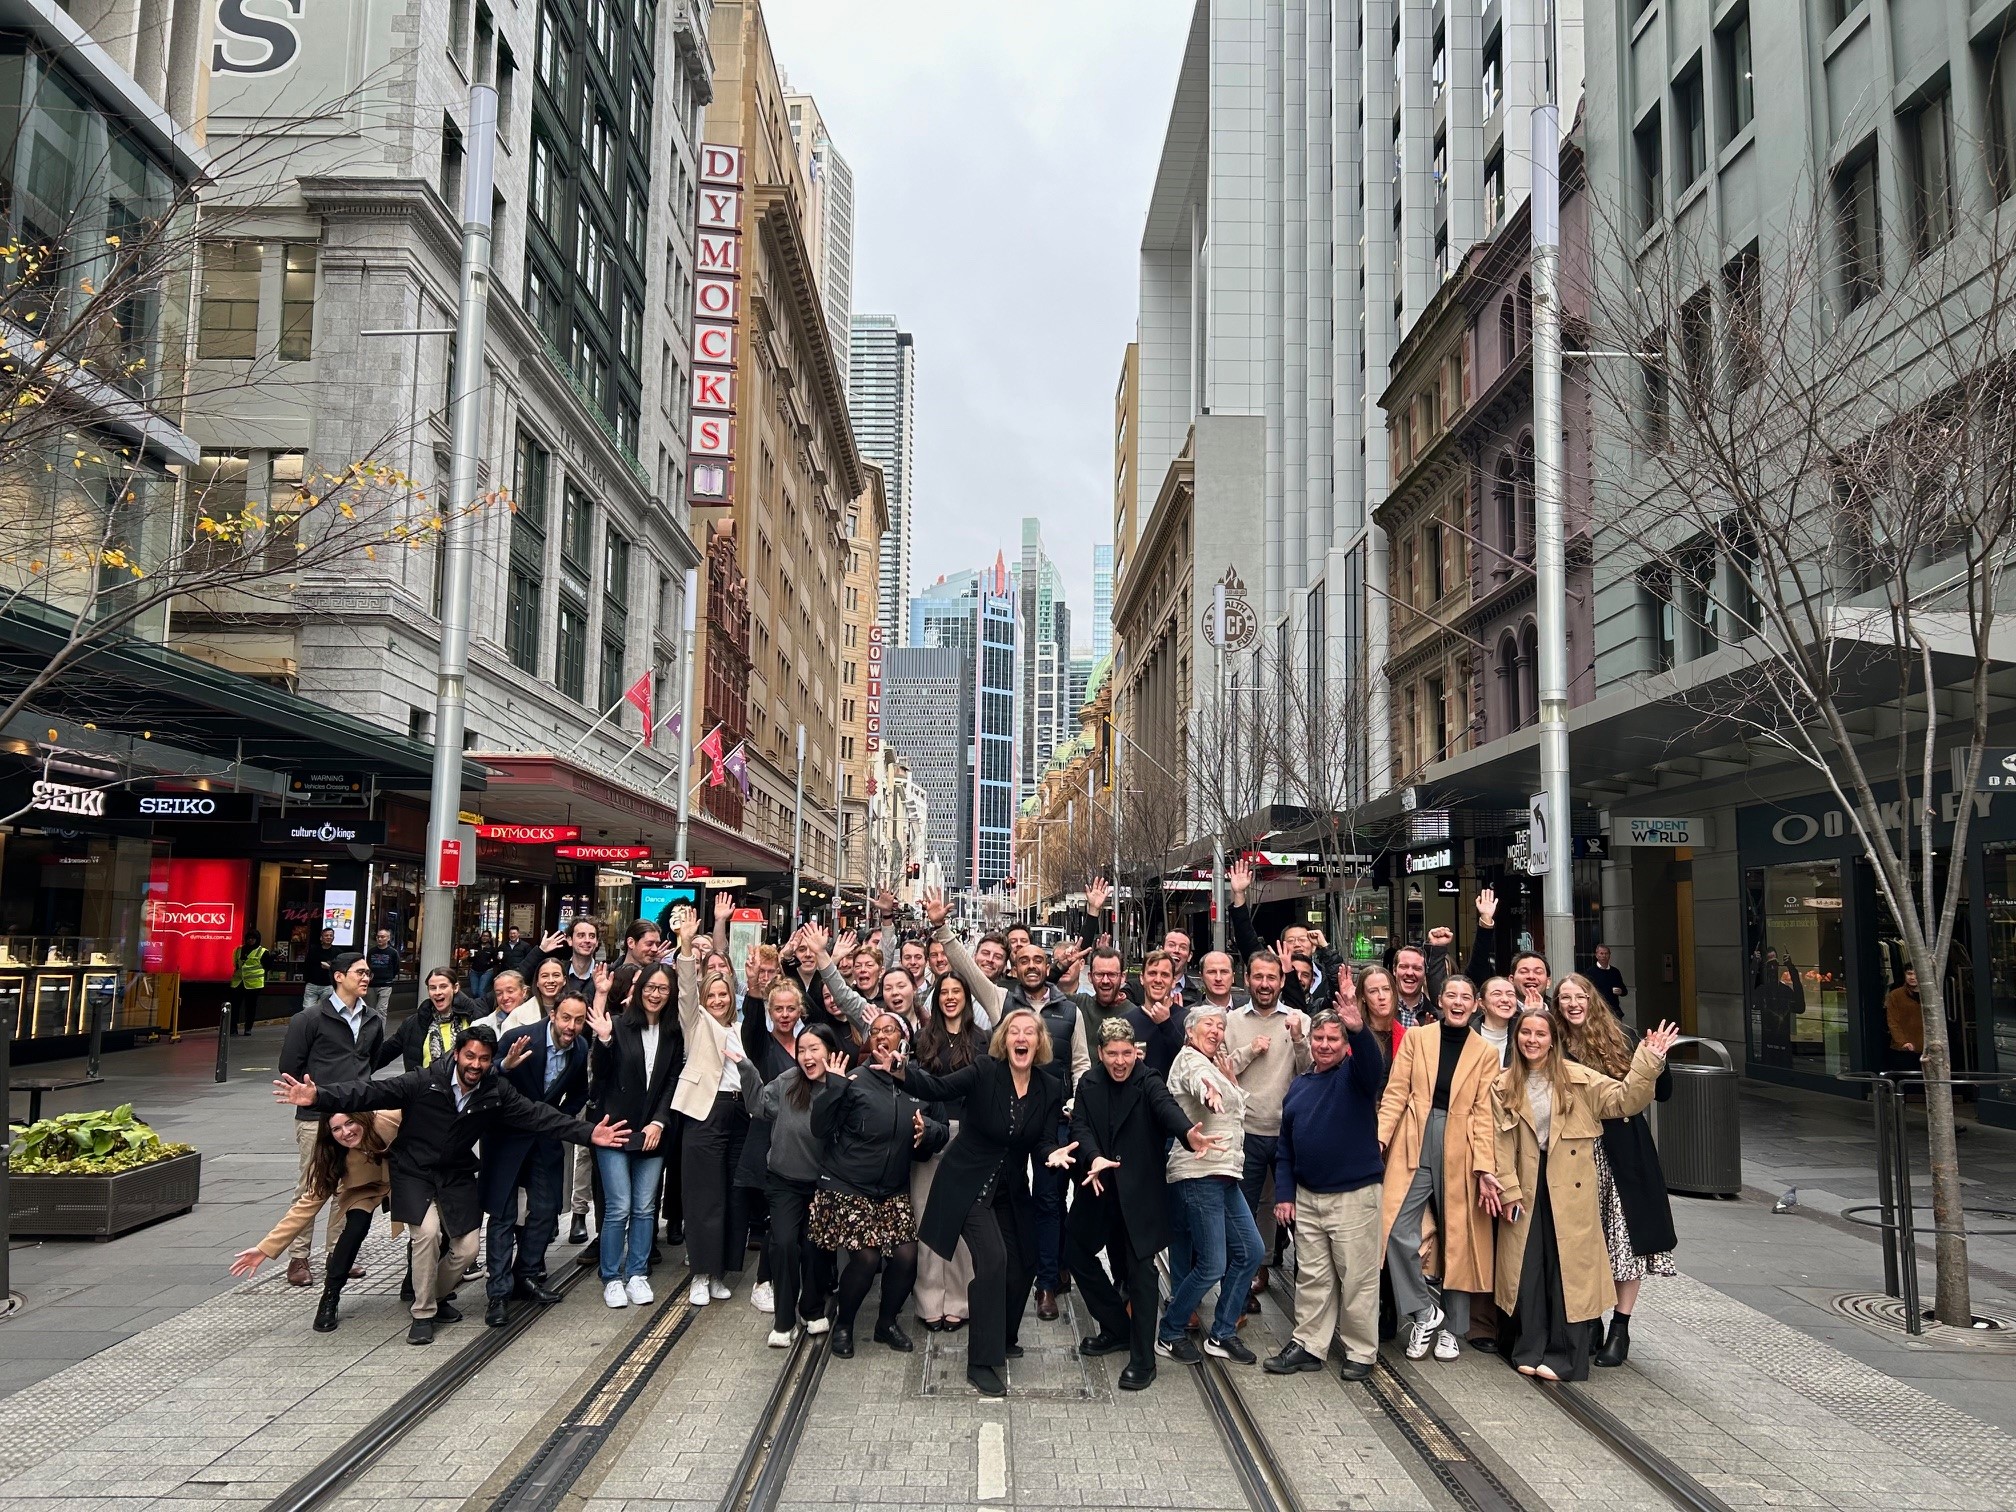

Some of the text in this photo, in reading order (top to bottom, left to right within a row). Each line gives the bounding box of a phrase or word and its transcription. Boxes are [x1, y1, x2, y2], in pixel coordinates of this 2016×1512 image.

[698, 149, 735, 449] DYMOCKS
[582, 453, 606, 494] BLOCK
[1236, 625, 1255, 648] FUND
[867, 627, 882, 750] GOWINGS
[311, 774, 344, 782] WARNING
[326, 783, 350, 791] Crossing
[32, 780, 105, 817] SEIK
[139, 798, 216, 814] SEIKO
[1631, 820, 1689, 831] STUDENT
[291, 826, 317, 837] culture
[336, 828, 356, 840] kings
[490, 827, 555, 840] DYMOCKS
[1515, 829, 1527, 844] THE
[576, 847, 630, 859] DYMOCKS
[1507, 843, 1527, 858] NORTH
[1413, 850, 1440, 872] michael
[1513, 857, 1528, 871] FACE
[1532, 850, 1549, 866] ONLY
[672, 869, 685, 878] 20
[1307, 863, 1353, 874] michael
[161, 912, 227, 925] DYMOCKS
[560, 909, 574, 917] 120
